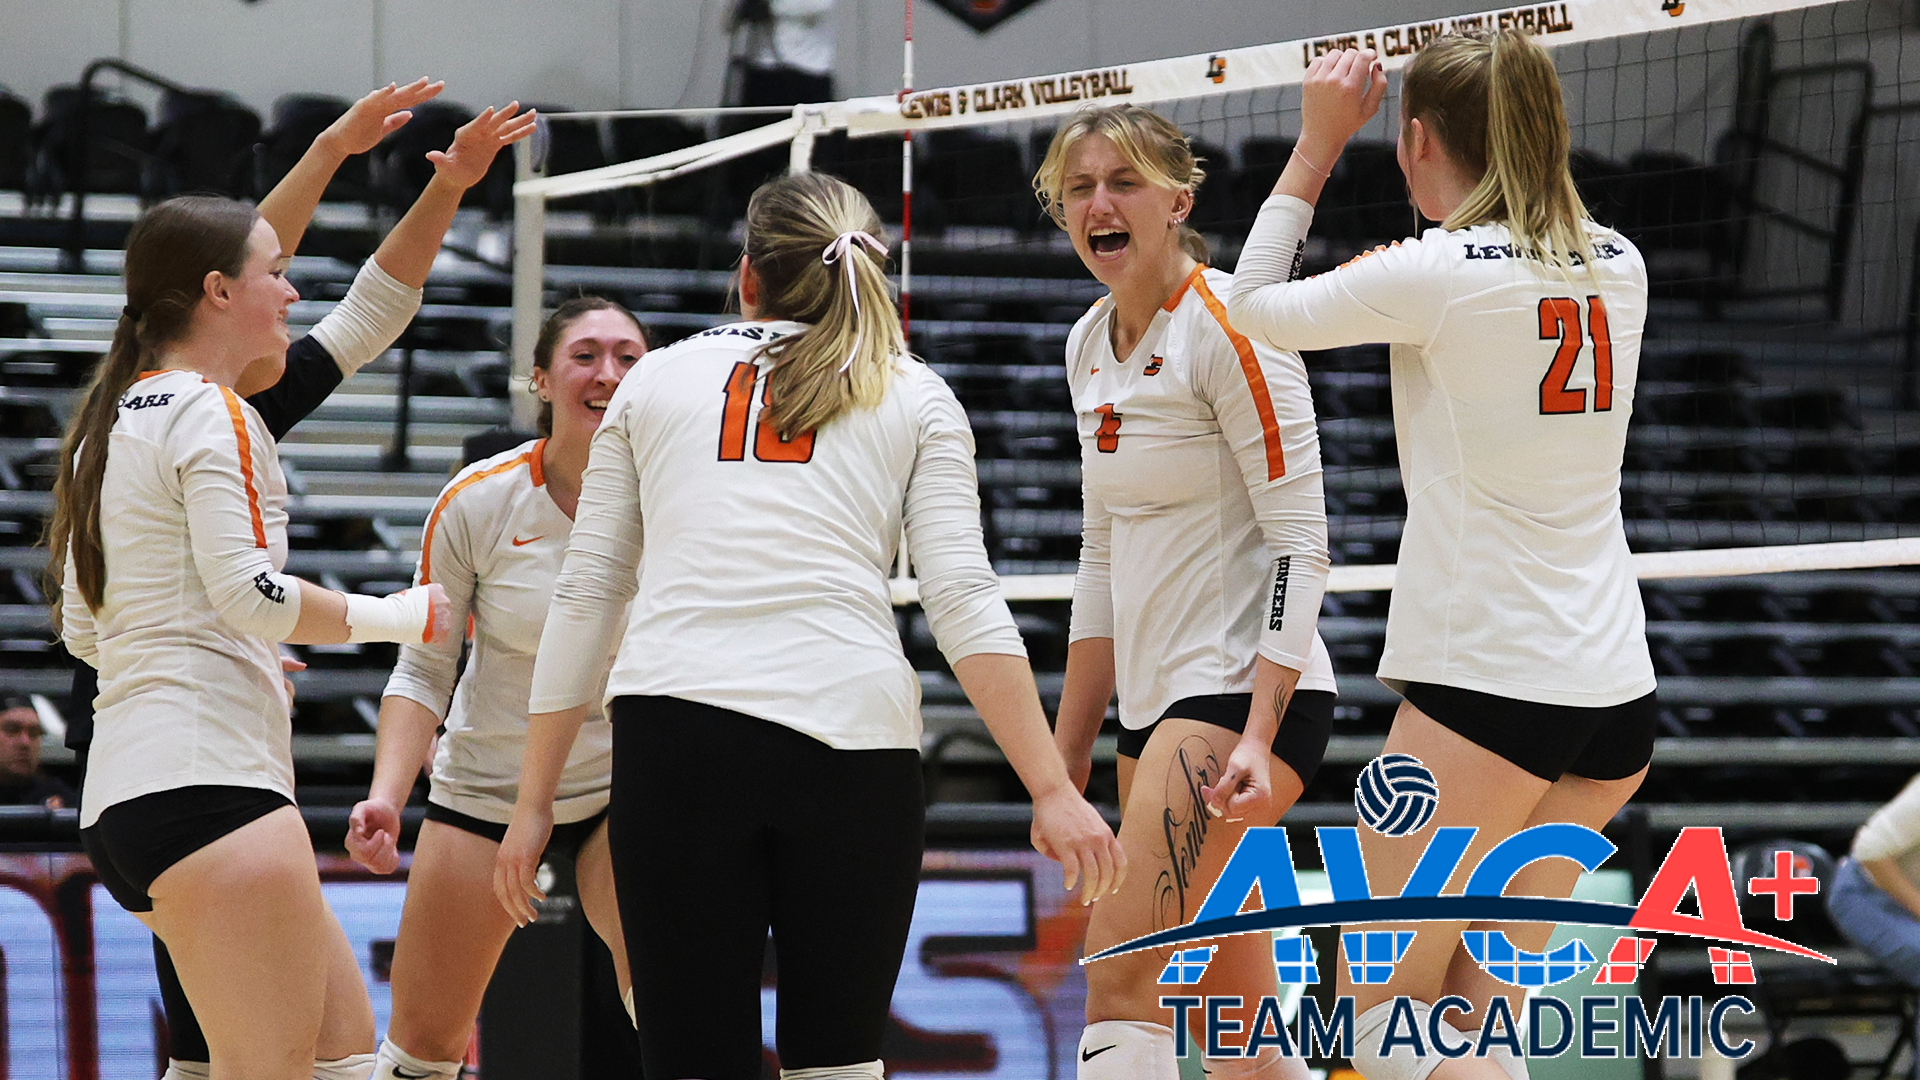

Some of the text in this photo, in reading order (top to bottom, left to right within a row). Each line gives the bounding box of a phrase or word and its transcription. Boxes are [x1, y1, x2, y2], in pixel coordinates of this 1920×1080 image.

[974, 81, 1026, 112] CLARK
[1030, 68, 1133, 105] VOLLEYBALL
[1538, 295, 1613, 415] 21
